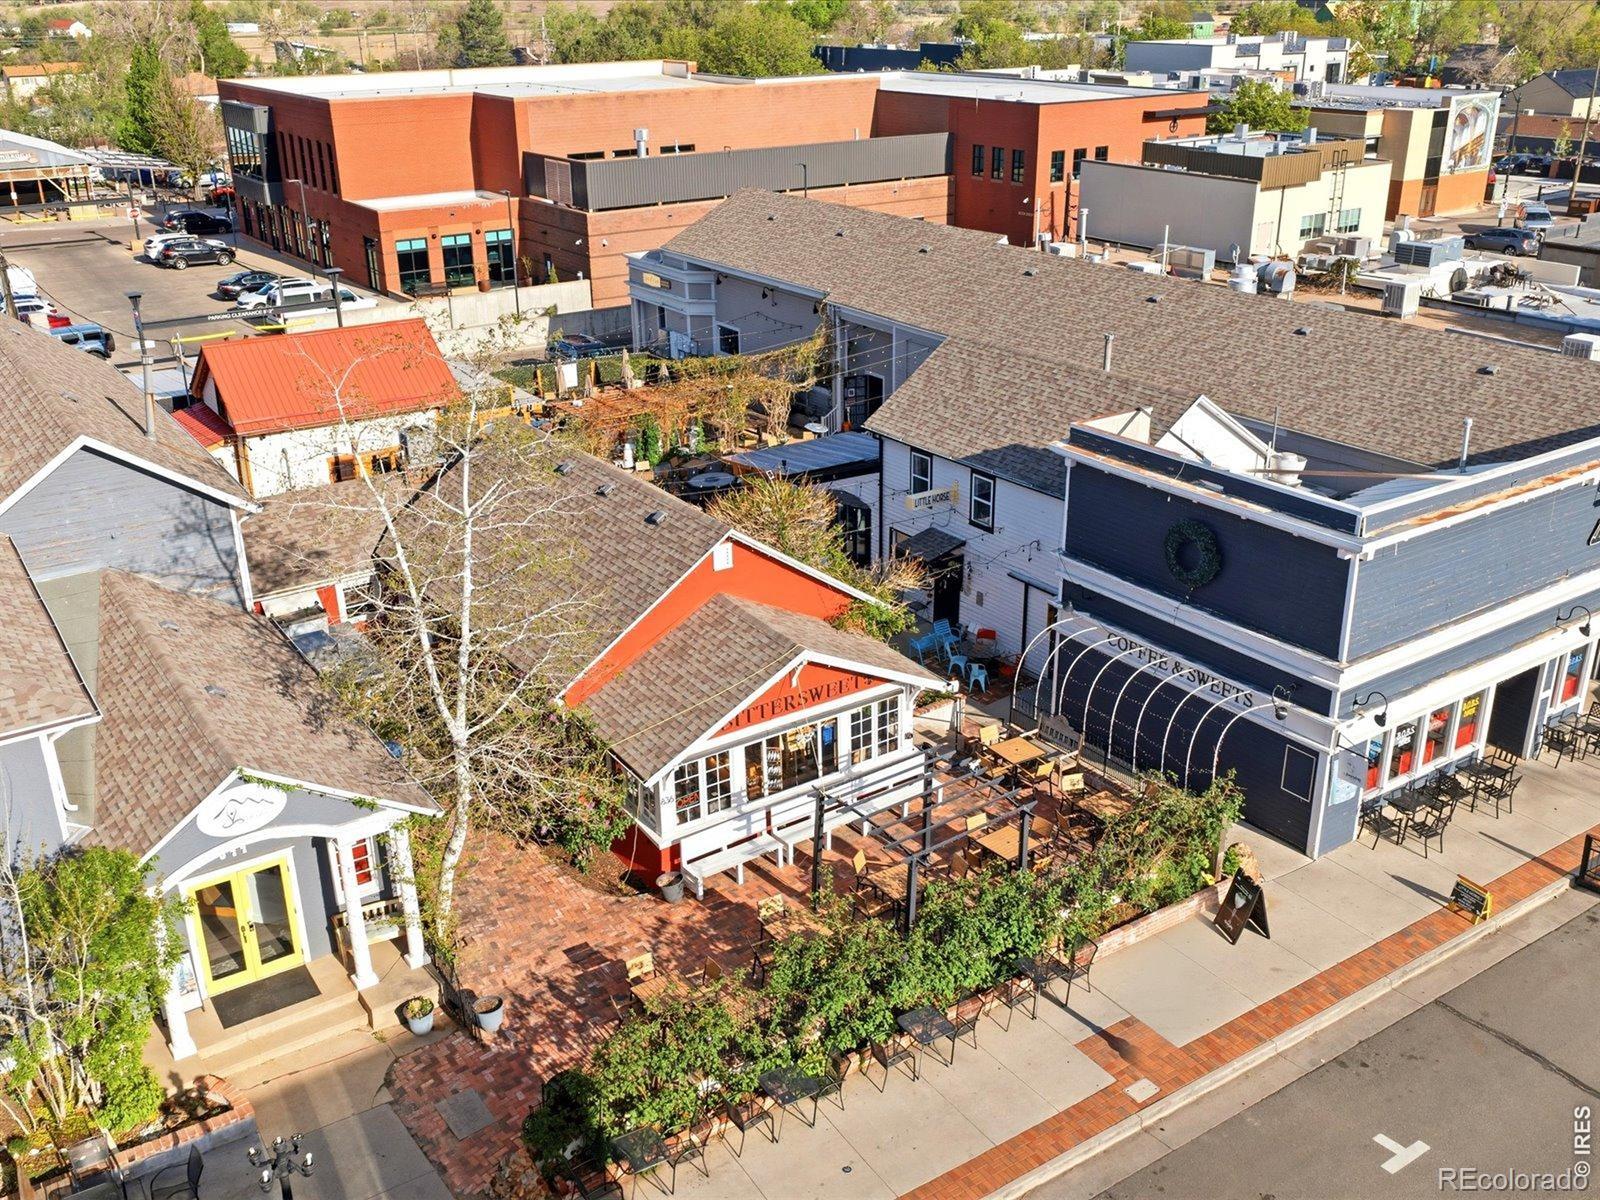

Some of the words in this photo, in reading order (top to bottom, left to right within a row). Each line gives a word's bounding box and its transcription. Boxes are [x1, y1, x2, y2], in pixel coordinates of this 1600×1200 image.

[207, 312, 232, 321] PARKING
[231, 308, 263, 319] CLEARANCE
[914, 495, 931, 508] LITTLE
[931, 491, 950, 503] HORSE
[1107, 632, 1168, 672] COFFEE
[1171, 660, 1184, 678] &
[1186, 667, 1254, 708] SWEETS
[721, 675, 861, 731] ITTERSWEET
[676, 790, 700, 809] OPEN
